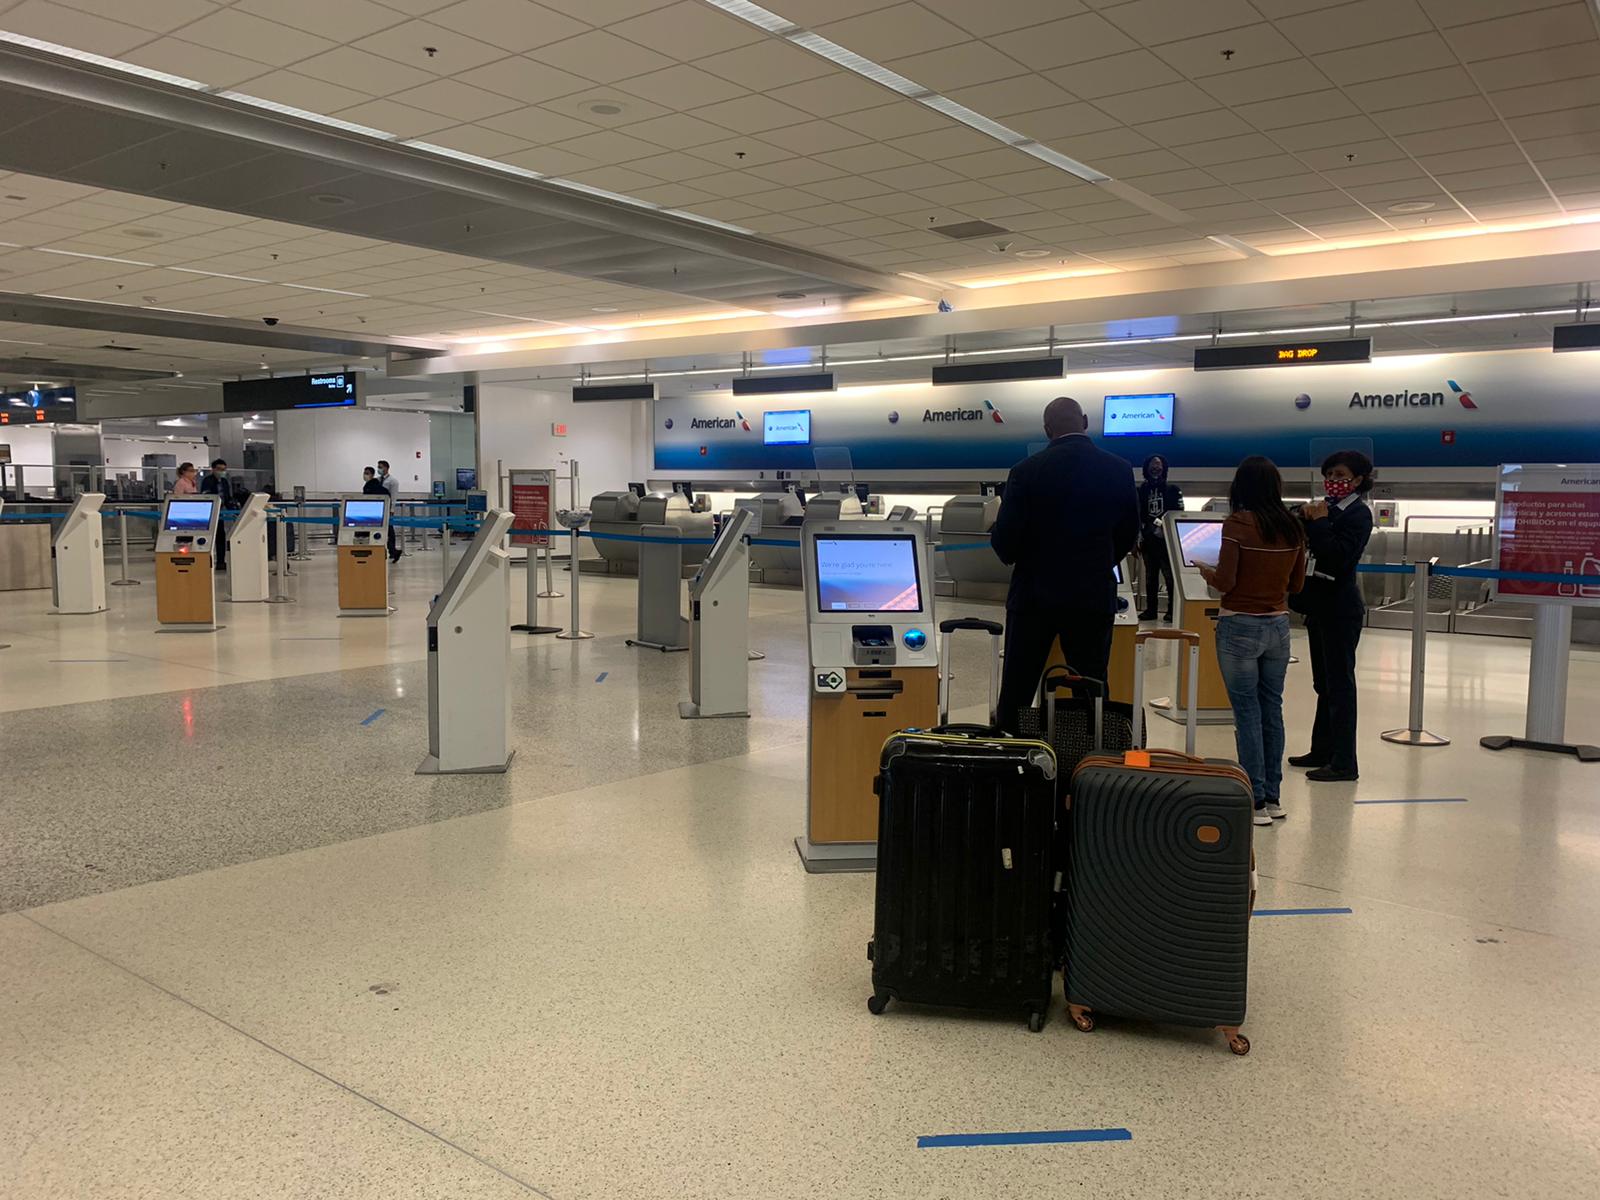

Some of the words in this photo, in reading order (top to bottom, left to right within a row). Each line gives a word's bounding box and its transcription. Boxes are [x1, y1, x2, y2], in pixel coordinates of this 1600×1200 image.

[1278, 350, 1294, 359] BAG
[1297, 348, 1318, 358] DROP
[1349, 390, 1444, 409] American
[922, 407, 983, 423] American
[691, 416, 736, 429] American
[1516, 518, 1556, 526] OHIBIDOS
